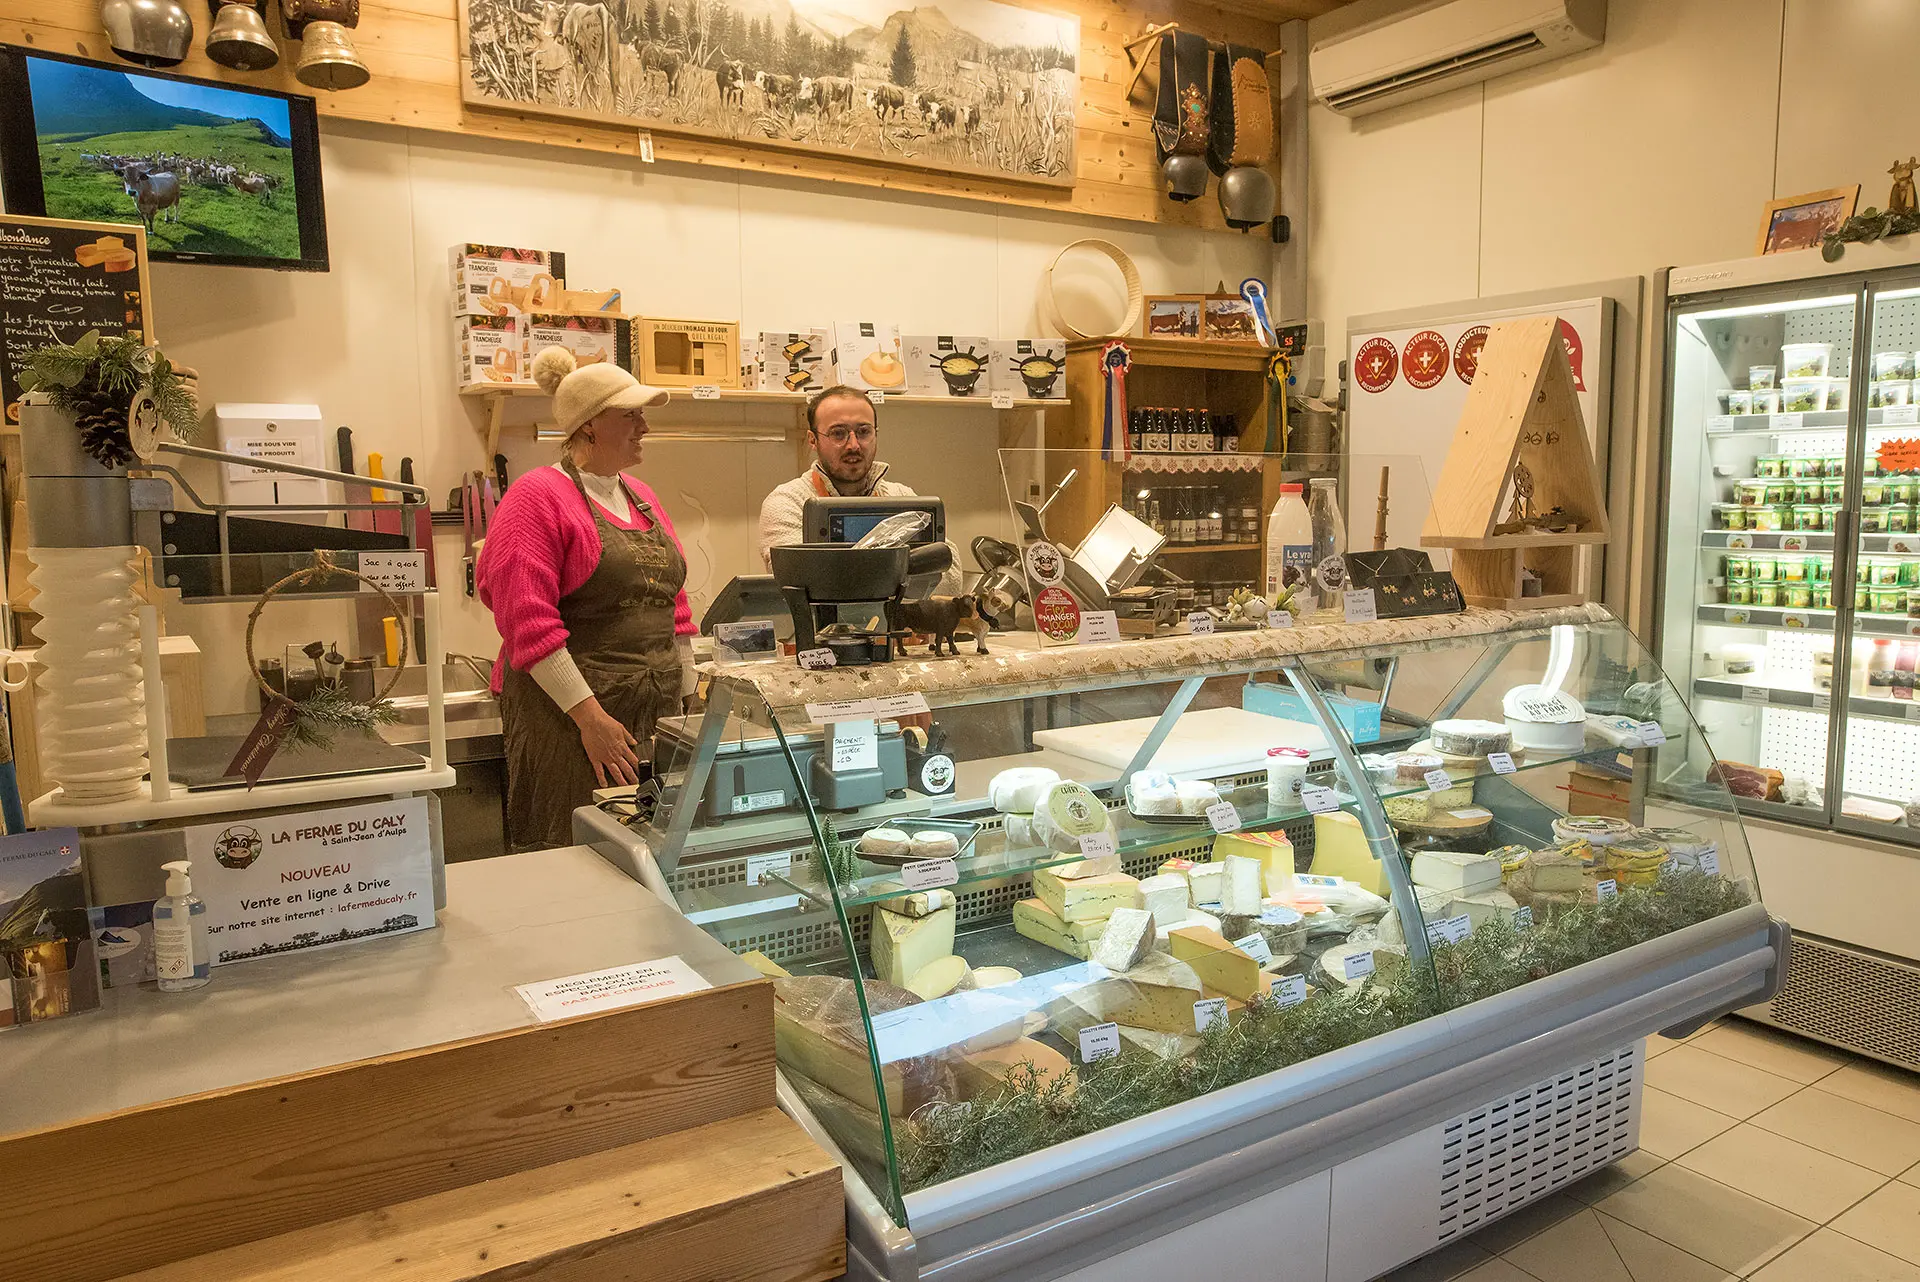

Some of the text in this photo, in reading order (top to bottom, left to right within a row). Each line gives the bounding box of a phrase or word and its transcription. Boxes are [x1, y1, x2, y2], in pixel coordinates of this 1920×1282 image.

[468, 264, 498, 273] TRANCHEUSE
[4, 283, 46, 298] fromage
[473, 335, 502, 344] TRANCHEUSE
[533, 334, 564, 343] TRANCHEUSE
[1404, 332, 1447, 356] ACTEUR LOCAL
[1357, 339, 1397, 362] ACTEUR LOCAL
[1286, 549, 1312, 559] Le vra
[1043, 612, 1076, 622] MANGER
[1523, 699, 1563, 712] FROMAGE
[1543, 704, 1568, 714] FOUR
[239, 733, 275, 774] Christmas
[271, 814, 406, 845] LA FERME DU CALY
[322, 826, 407, 846] à Saint-Jean d'Aulps
[280, 862, 351, 884] NOUVEAU
[240, 878, 391, 911] Vente en ligne & Drive
[207, 925, 225, 935] Sur
[228, 919, 257, 931] notre
[260, 915, 281, 927] site
[284, 907, 325, 922] internet
[337, 890, 418, 913] lafermeducaly.fr
[545, 969, 672, 997] ESPECES OU CARTE
[555, 967, 653, 989] REGLEMENT EN
[579, 979, 648, 996] BANCAIRE
[561, 979, 676, 1006] PAS DE CHEQUES
